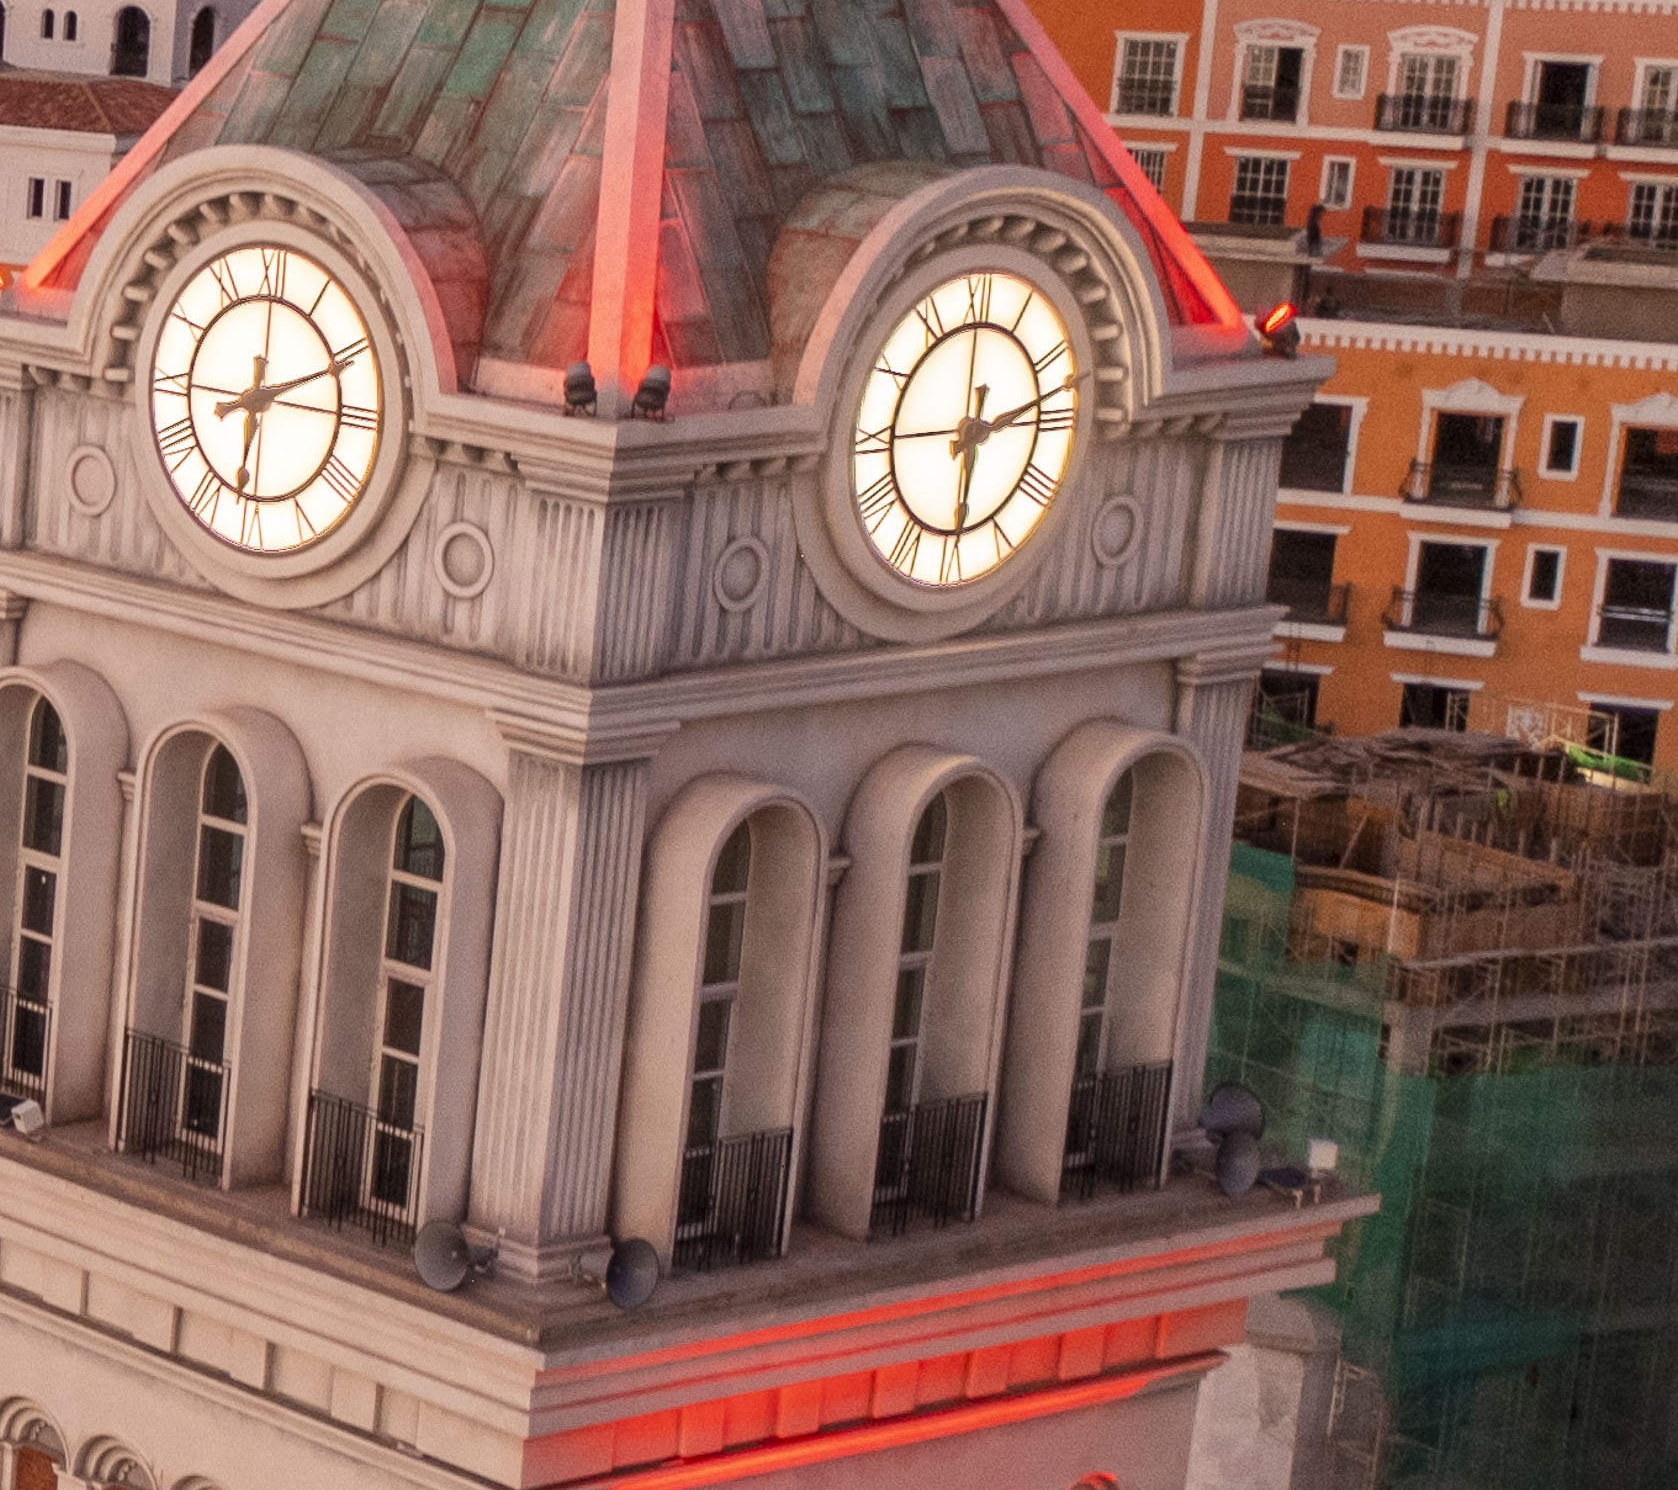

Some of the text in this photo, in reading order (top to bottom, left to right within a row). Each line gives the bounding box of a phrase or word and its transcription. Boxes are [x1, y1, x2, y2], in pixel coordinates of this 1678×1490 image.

[209, 257, 239, 309] XI
[260, 249, 287, 297] XII
[308, 279, 331, 317] I
[963, 276, 992, 323] XII
[1010, 291, 1033, 335] I
[172, 300, 206, 342] X
[915, 296, 944, 349] XI
[334, 337, 369, 365] II
[875, 354, 911, 391] X
[1033, 340, 1070, 374] II
[155, 367, 189, 396] IX
[341, 404, 378, 430] III
[1038, 408, 1074, 432] III
[158, 417, 197, 473] VIII
[856, 426, 891, 454] IX
[189, 470, 224, 528] VII
[294, 497, 318, 542] V
[858, 472, 898, 534] VIII
[240, 498, 263, 547] VI
[992, 518, 1015, 560] V
[889, 518, 923, 577] VII
[940, 536, 962, 583] VI
